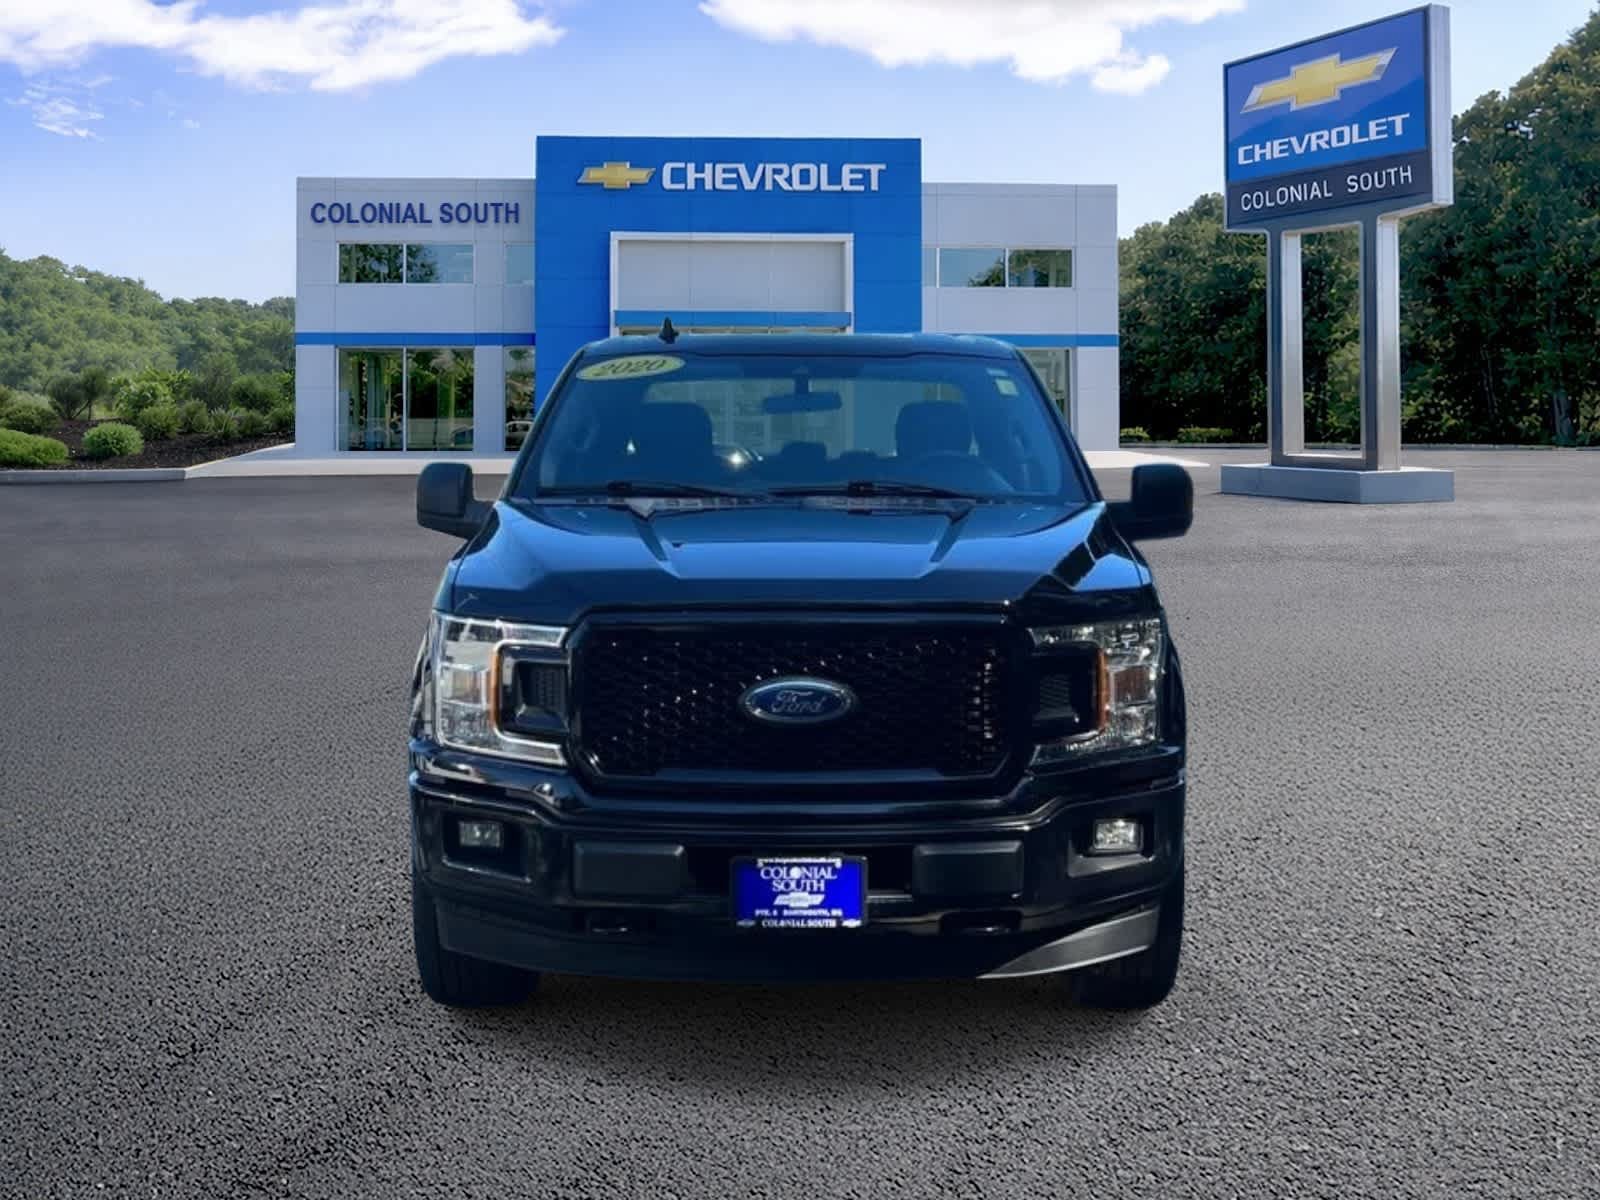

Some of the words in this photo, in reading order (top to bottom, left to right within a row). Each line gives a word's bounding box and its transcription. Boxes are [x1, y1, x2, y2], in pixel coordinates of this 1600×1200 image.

[1238, 113, 1410, 165] CHEVROLET
[662, 162, 887, 192] CHEVROLET
[1240, 180, 1333, 212] COLONIAL
[1346, 165, 1413, 193] SOUTH
[310, 202, 433, 225] COLONIAL
[439, 202, 520, 225] SOUTH
[592, 359, 667, 377] 2020
[771, 690, 827, 713] Ford
[760, 866, 838, 880] COLONIAL
[772, 879, 825, 892] SOUTH
